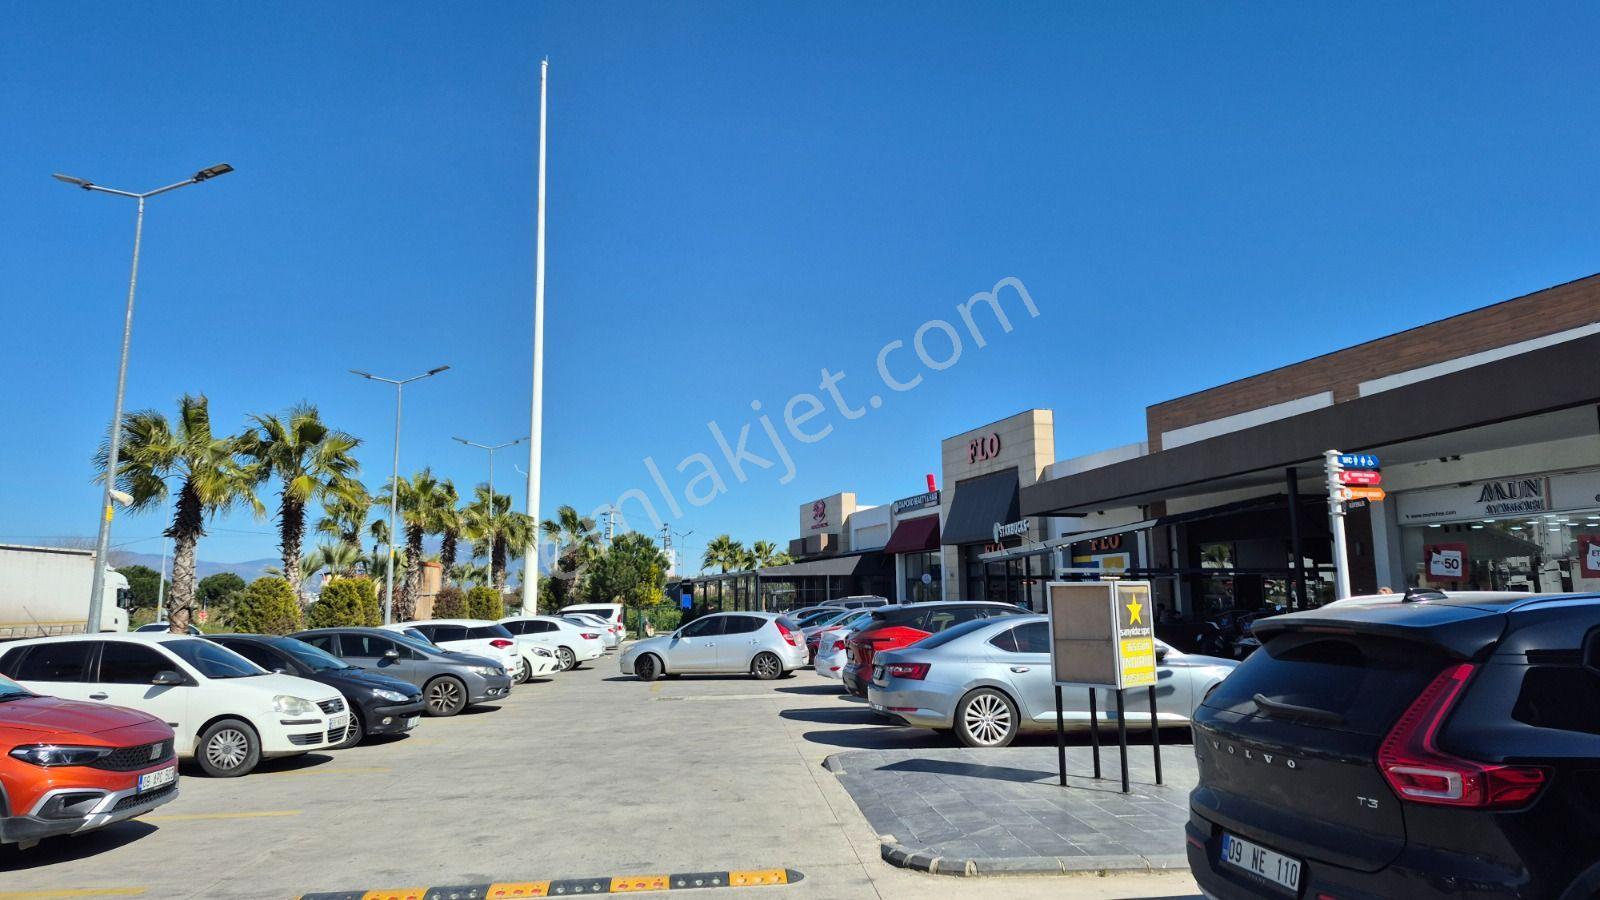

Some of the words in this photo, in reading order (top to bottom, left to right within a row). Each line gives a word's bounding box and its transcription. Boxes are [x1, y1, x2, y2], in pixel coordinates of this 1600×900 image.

[967, 433, 1000, 464] FLO
[1342, 456, 1353, 464] WC
[1477, 480, 1538, 502] MUN
[1000, 519, 1030, 537] STARBUCKS
[1090, 534, 1121, 552] FLO
[1212, 741, 1297, 769] VOLVO
[1356, 796, 1379, 809] T3
[1229, 839, 1242, 862] 09
[1252, 847, 1266, 874] NE
[1278, 858, 1298, 887] 110
